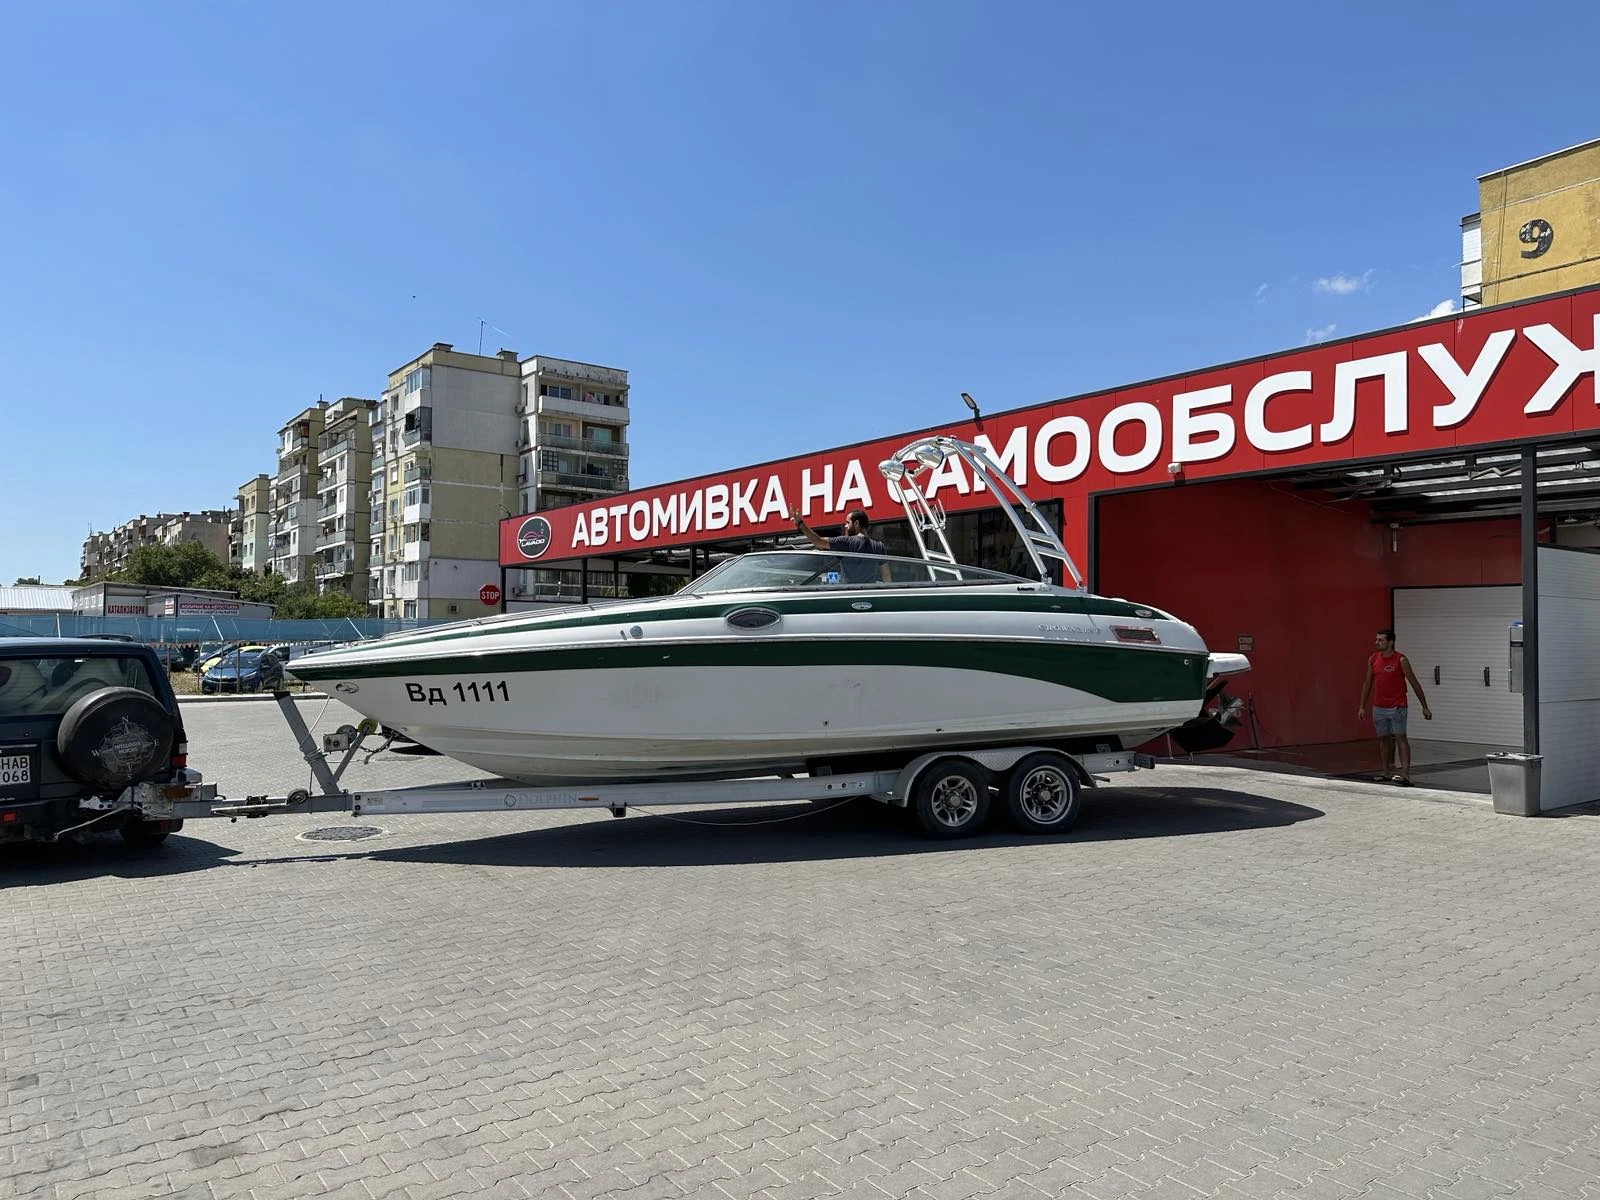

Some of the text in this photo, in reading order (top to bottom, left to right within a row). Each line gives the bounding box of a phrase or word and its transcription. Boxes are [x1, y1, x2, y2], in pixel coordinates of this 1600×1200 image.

[1519, 219, 1554, 259] 9
[571, 474, 790, 549] АВТОМИВКА
[801, 458, 873, 515] НА
[481, 591, 500, 600] STOP
[453, 680, 510, 702] 1111
